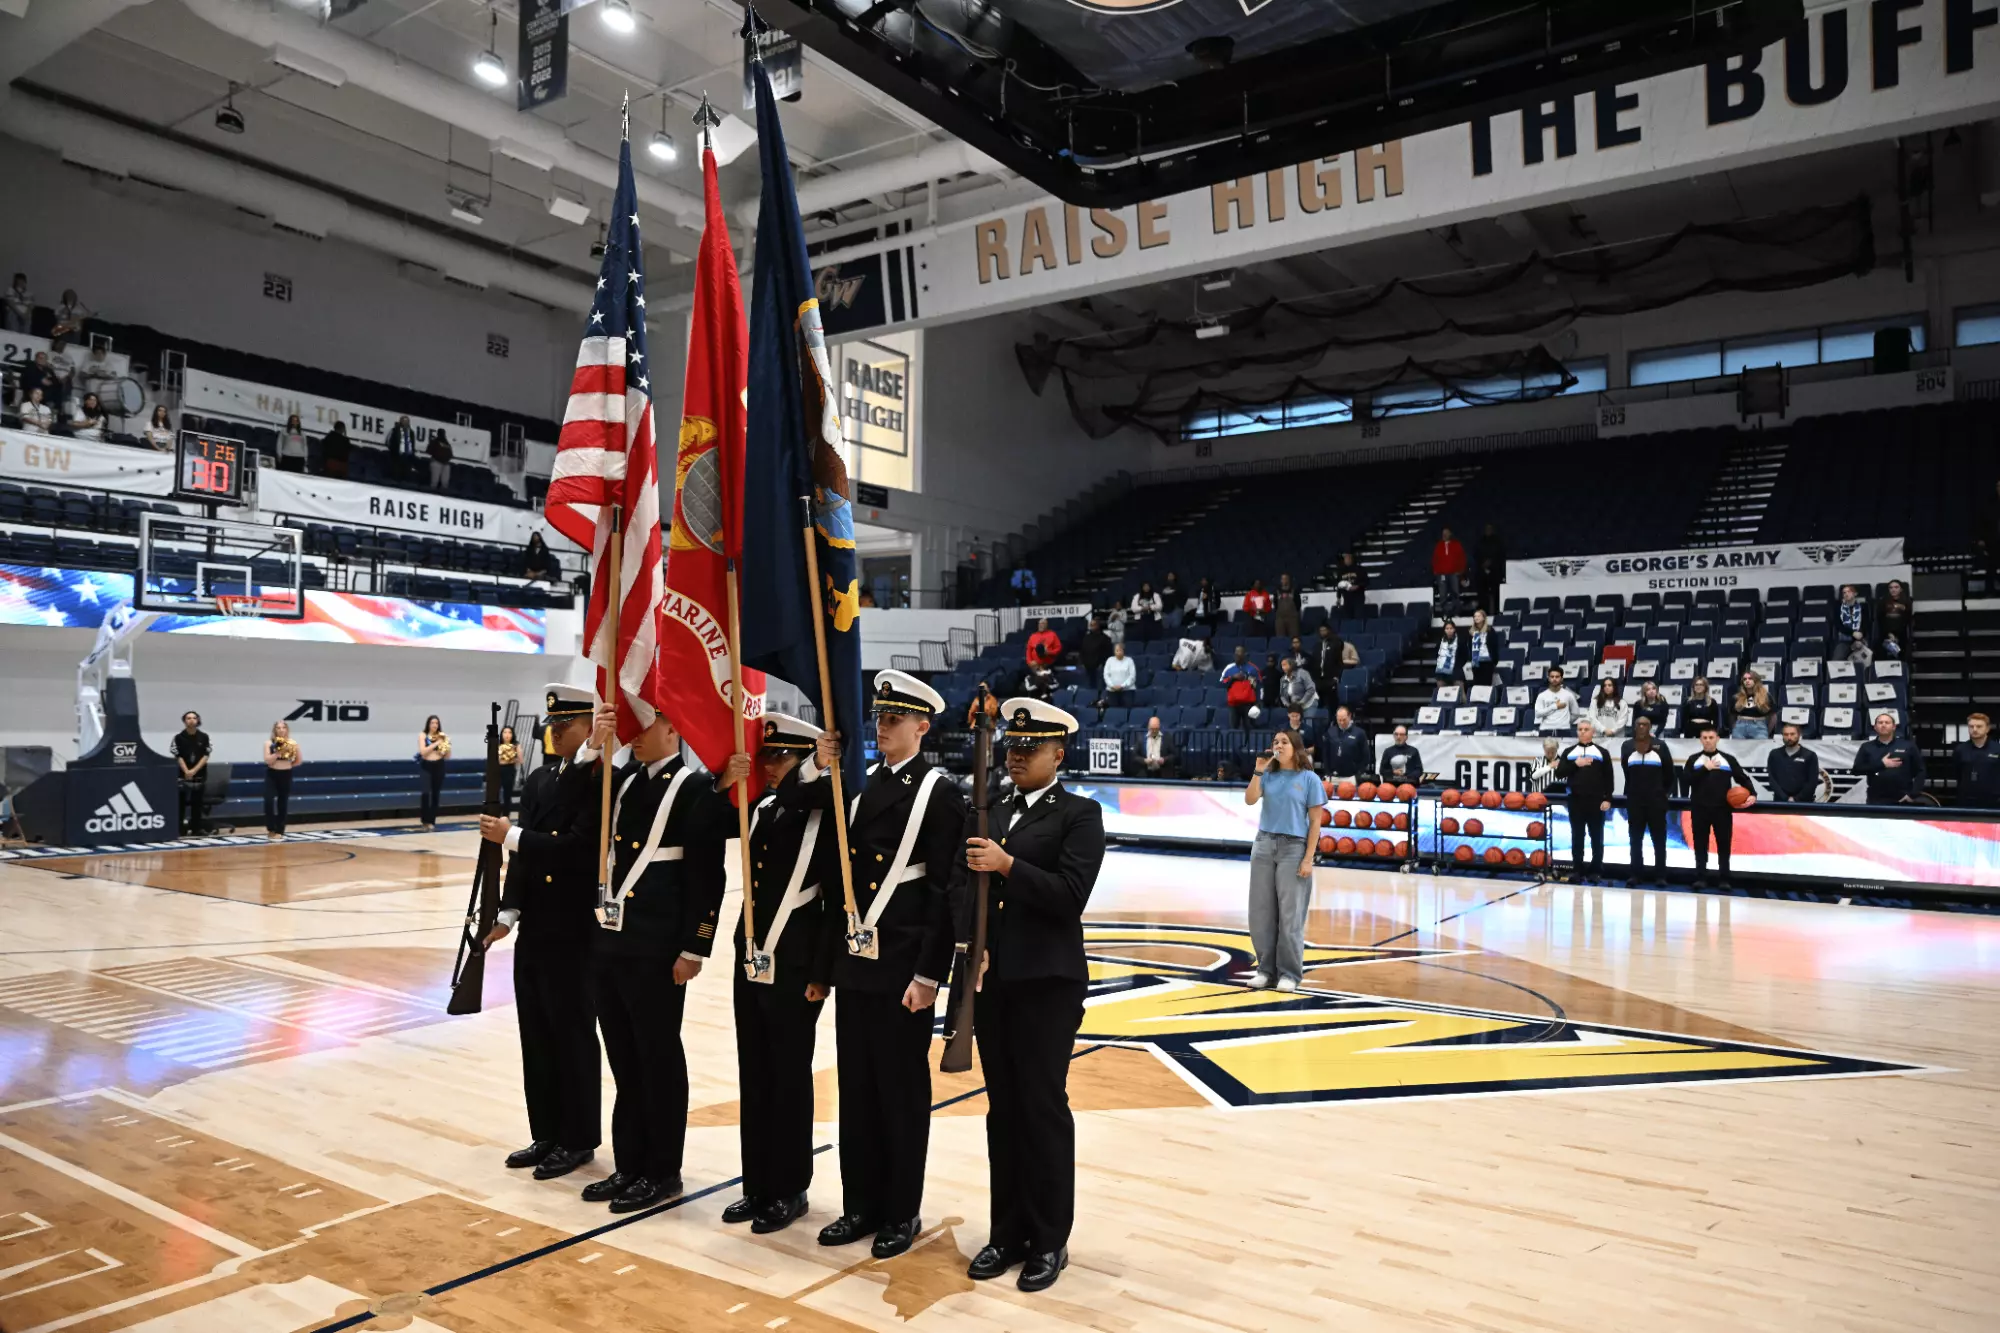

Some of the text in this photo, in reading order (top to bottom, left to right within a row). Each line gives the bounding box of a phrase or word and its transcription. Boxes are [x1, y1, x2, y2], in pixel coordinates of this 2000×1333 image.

[533, 40, 552, 58] 2015
[532, 53, 552, 71] 2017
[531, 66, 552, 86] 2022
[975, 199, 1171, 285] RAISE
[1211, 138, 1404, 234] HIGH
[263, 280, 292, 302] 221
[814, 264, 867, 312] GW
[486, 341, 509, 358] 222
[846, 356, 904, 401] RAISE
[1915, 376, 1946, 392] 204
[257, 393, 303, 420] HAIL
[315, 404, 340, 425] TO
[350, 411, 385, 435] THE
[847, 396, 905, 433] HIGH
[1601, 412, 1626, 427] 203
[24, 443, 71, 471] GW
[191, 457, 229, 492] 30
[370, 496, 485, 530] RAISE HIGH
[1605, 549, 1782, 574] GEORGE'S ARMY
[1648, 574, 1738, 590] SECTION 103
[1026, 606, 1080, 617] SECTION 101
[283, 698, 369, 722] A10
[113, 745, 138, 757] GW
[1090, 742, 1120, 751] SECTION
[1092, 751, 1119, 769] 102
[85, 812, 166, 833] adidas
